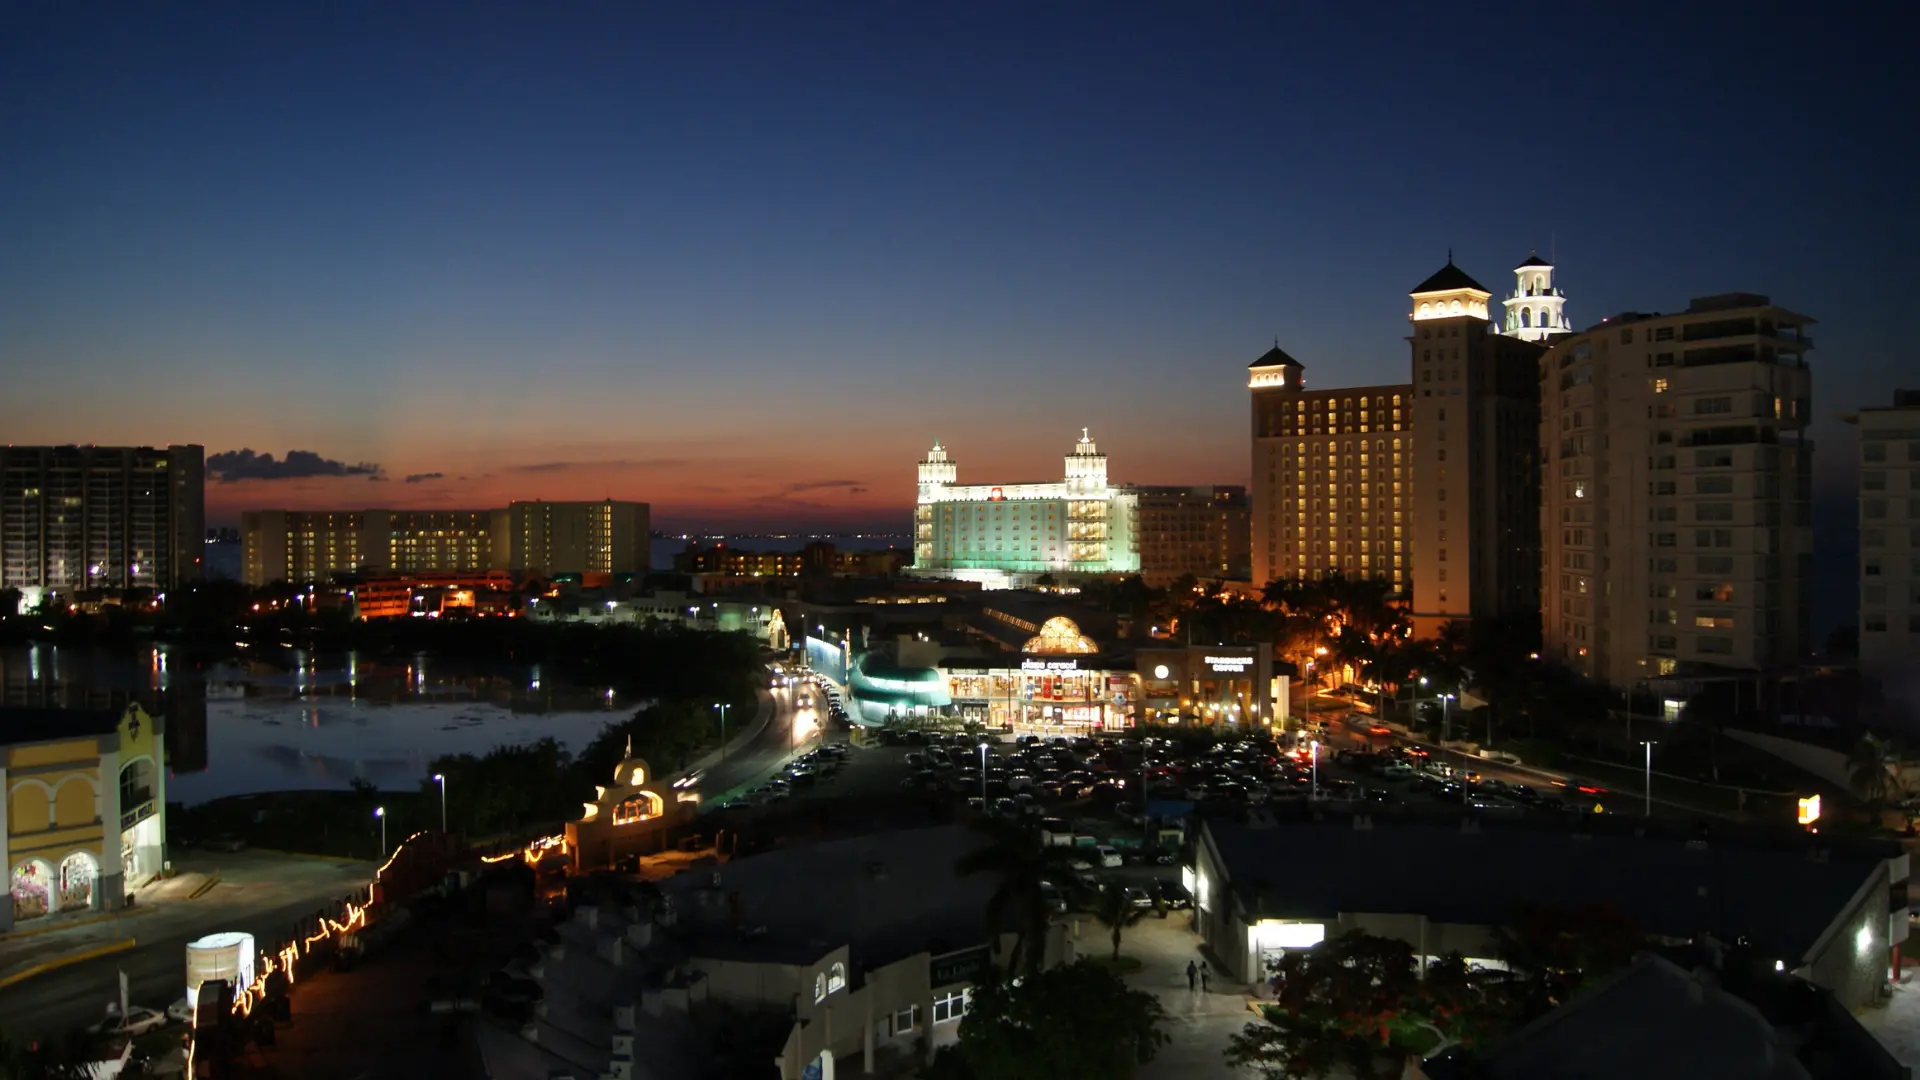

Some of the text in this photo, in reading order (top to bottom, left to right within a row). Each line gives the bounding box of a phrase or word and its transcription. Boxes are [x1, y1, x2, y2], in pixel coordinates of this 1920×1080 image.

[1021, 658, 1077, 670] plaza caracol
[1204, 656, 1253, 665] STARBUCKS
[1212, 664, 1244, 672] COFFEE
